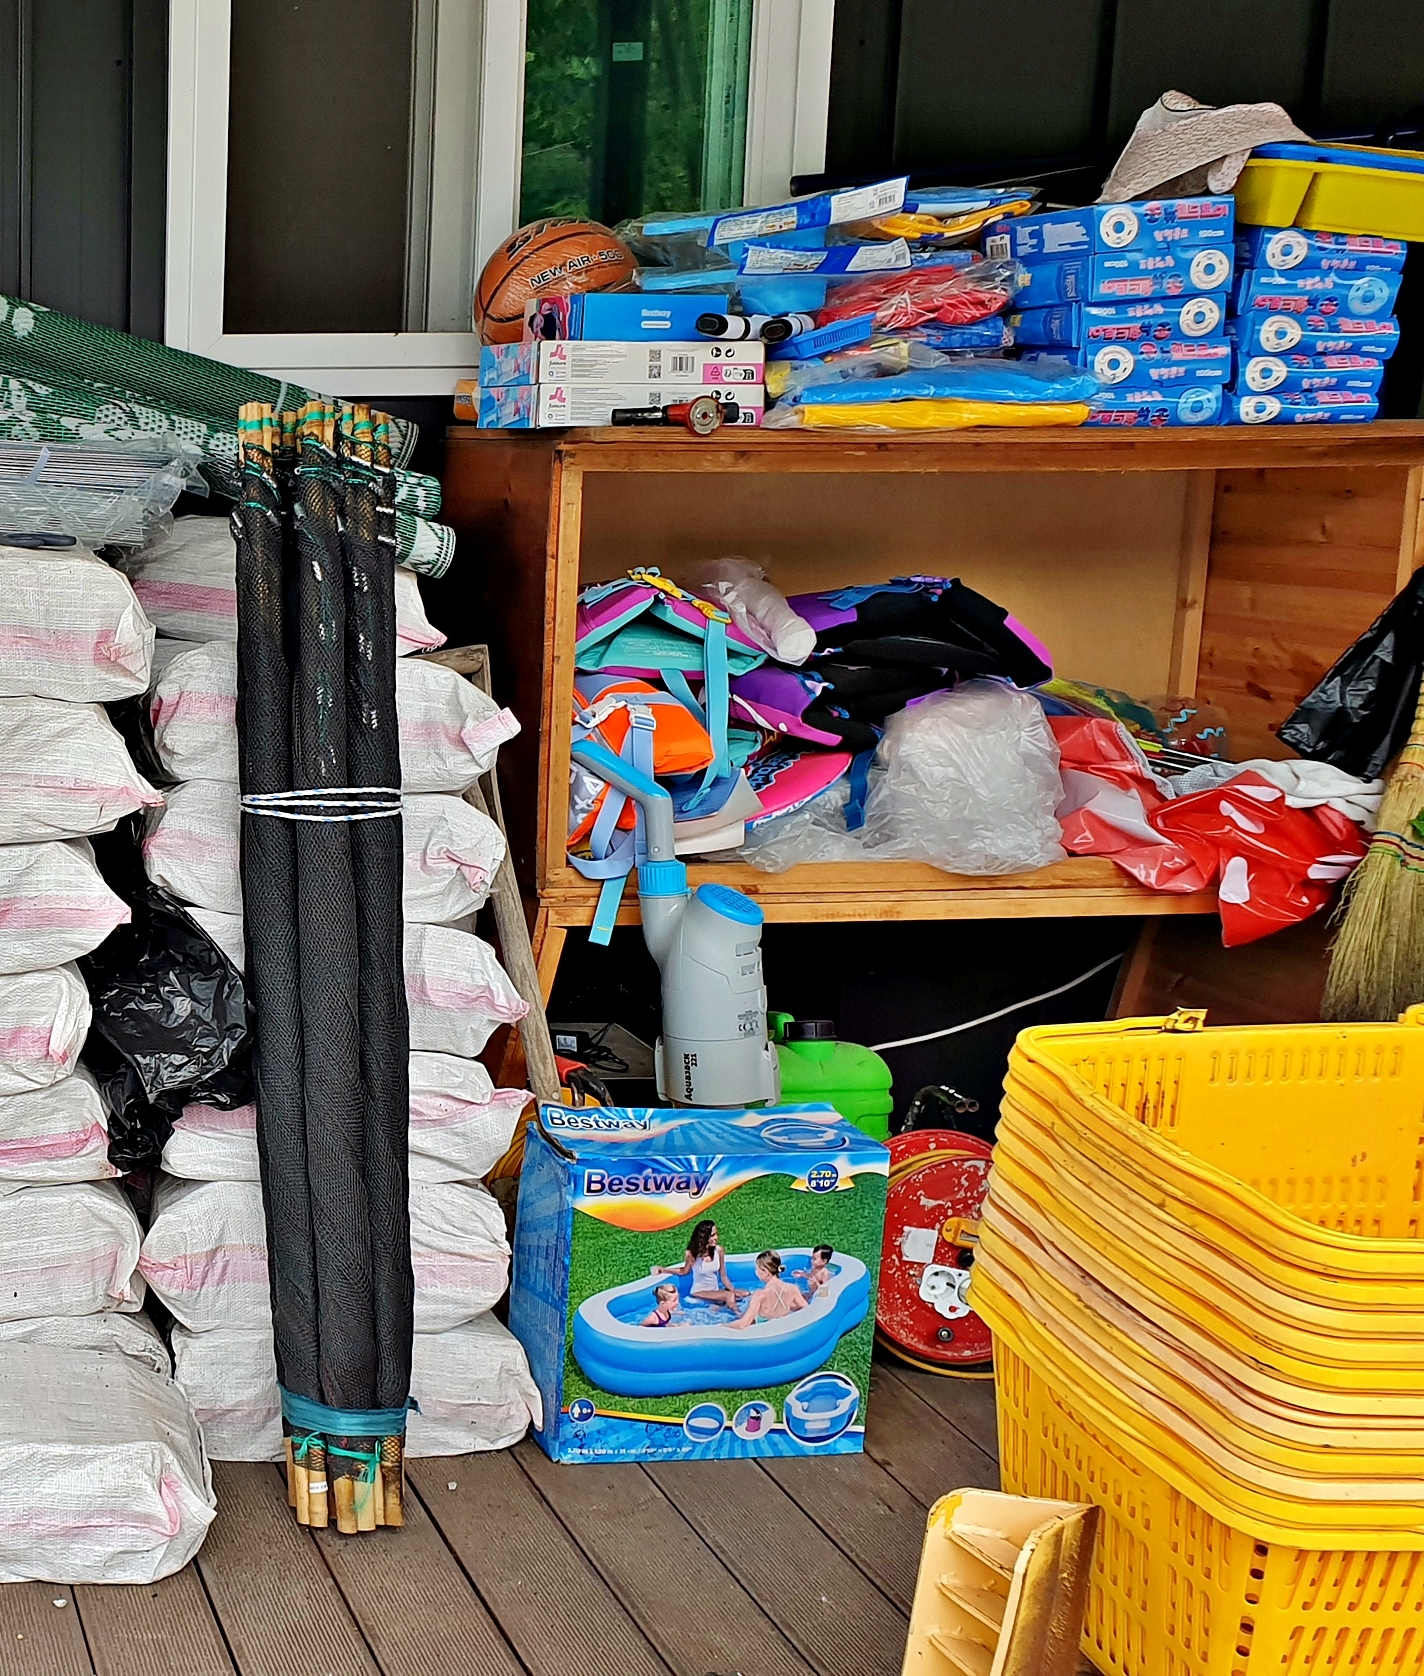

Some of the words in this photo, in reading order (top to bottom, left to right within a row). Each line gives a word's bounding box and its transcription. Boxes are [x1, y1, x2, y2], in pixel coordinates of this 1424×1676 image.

[529, 264, 564, 289] NEW
[566, 255, 591, 273] AIR
[690, 1052, 698, 1067] 221
[547, 1107, 650, 1131] Bestway
[584, 1168, 714, 1199] Bestway
